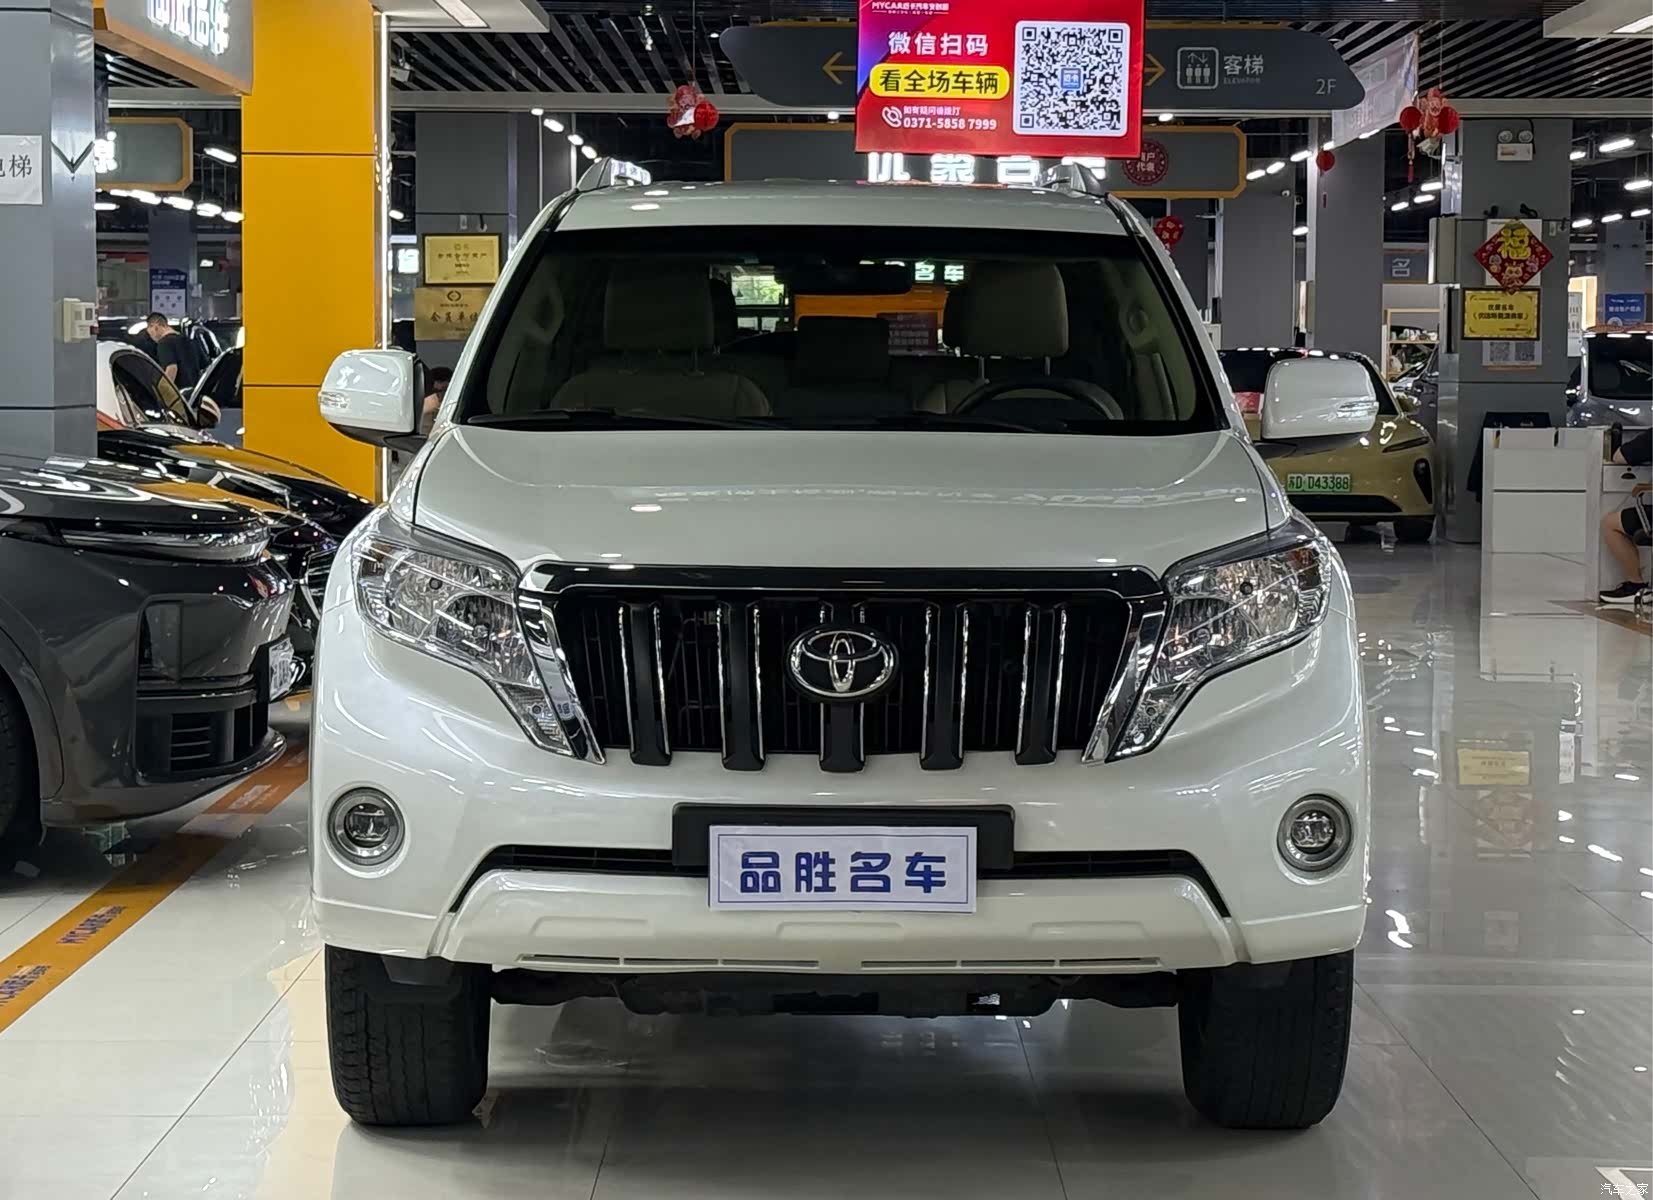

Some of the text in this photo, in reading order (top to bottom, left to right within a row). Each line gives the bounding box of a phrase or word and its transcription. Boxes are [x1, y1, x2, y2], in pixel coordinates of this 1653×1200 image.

[888, 31, 988, 56] 微信扫码
[1223, 54, 1264, 76] 客梯
[879, 69, 998, 94] 看全场车辆
[1315, 78, 1337, 95] 2F
[903, 117, 997, 130] 0371-5858 7999
[0, 153, 33, 178] 梯
[1307, 476, 1350, 490] D43388
[740, 850, 947, 893] 品胜名车
